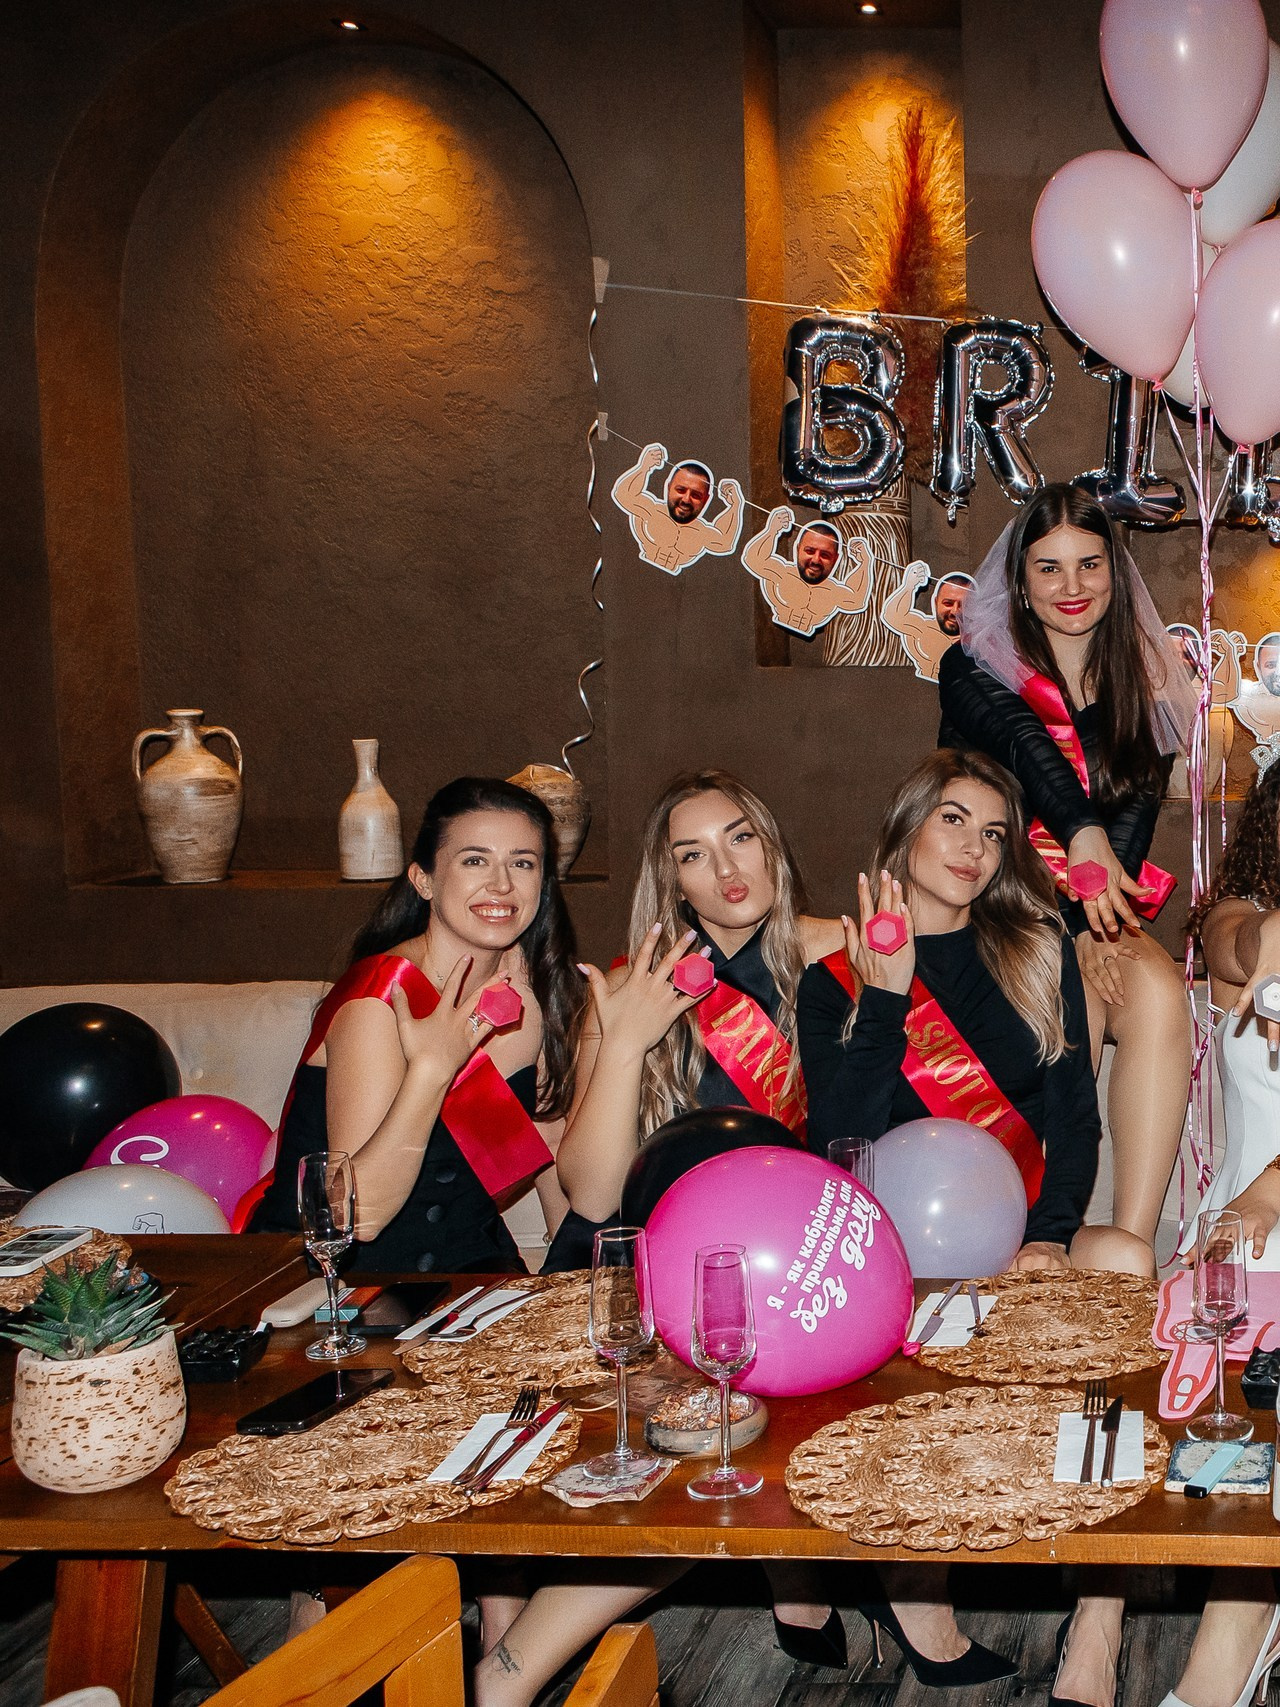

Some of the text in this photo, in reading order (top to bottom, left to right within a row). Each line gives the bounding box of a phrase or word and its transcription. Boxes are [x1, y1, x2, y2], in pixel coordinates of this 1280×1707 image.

[908, 1021, 989, 1102] SHOT
[786, 1259, 806, 1284] як
[798, 1178, 837, 1259] кабріолет:
[789, 1190, 881, 1334] без даху
[800, 1180, 852, 1294] прикольна, але
